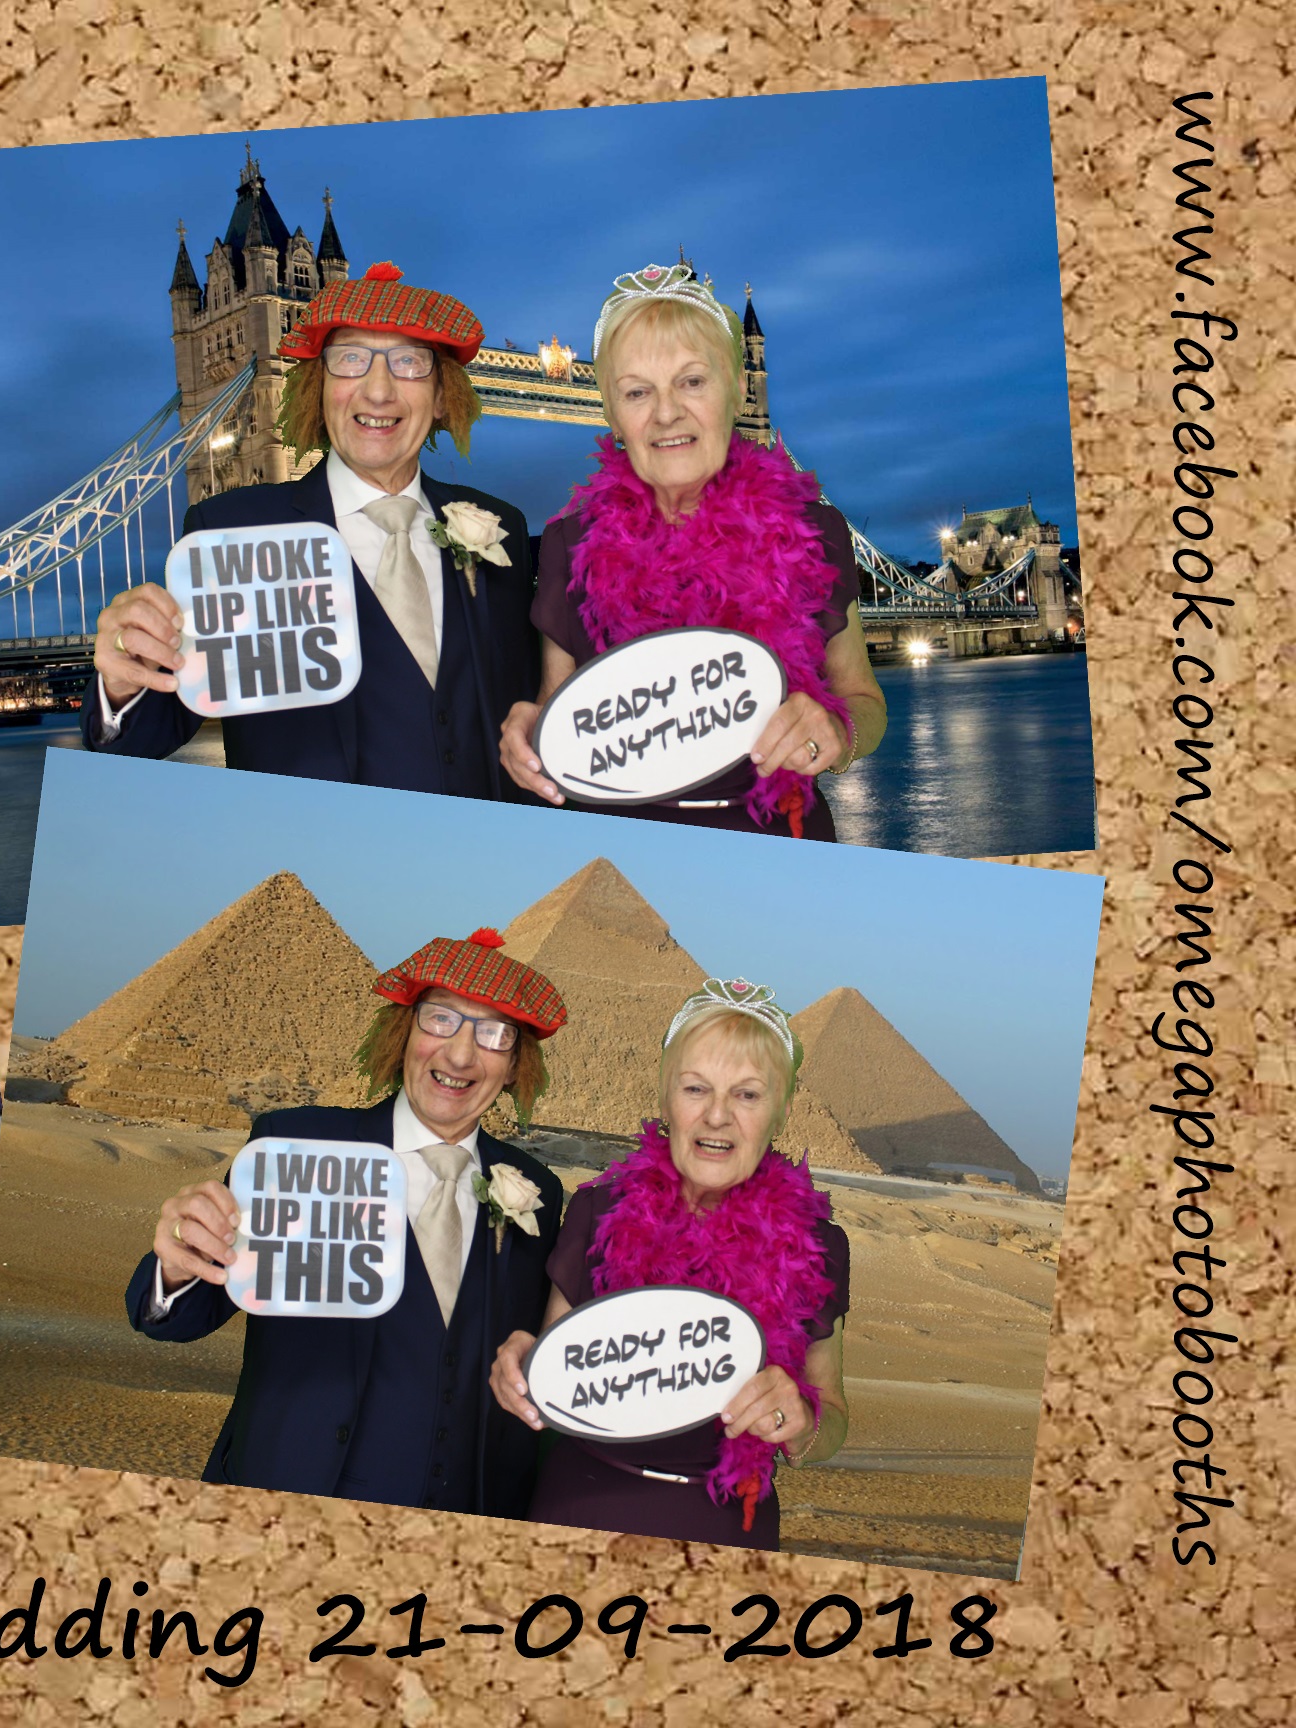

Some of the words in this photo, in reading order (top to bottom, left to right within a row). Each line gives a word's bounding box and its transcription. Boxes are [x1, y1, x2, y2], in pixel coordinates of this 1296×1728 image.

[189, 547, 203, 589] I
[212, 537, 333, 586] WOKE
[192, 593, 245, 636] UP
[256, 584, 336, 630] LIKE
[194, 627, 342, 703] THIS
[573, 676, 676, 738] READY
[691, 651, 746, 695] FOR
[590, 689, 758, 776] ANYTHING
[253, 1151, 267, 1191] I
[276, 1153, 389, 1198] WOKE
[251, 1197, 301, 1238] UP
[310, 1201, 386, 1242] LIKE
[248, 1238, 384, 1306] THIS
[564, 1328, 665, 1371] READY
[678, 1316, 731, 1350] FOR
[571, 1353, 736, 1409] ANYTHING
